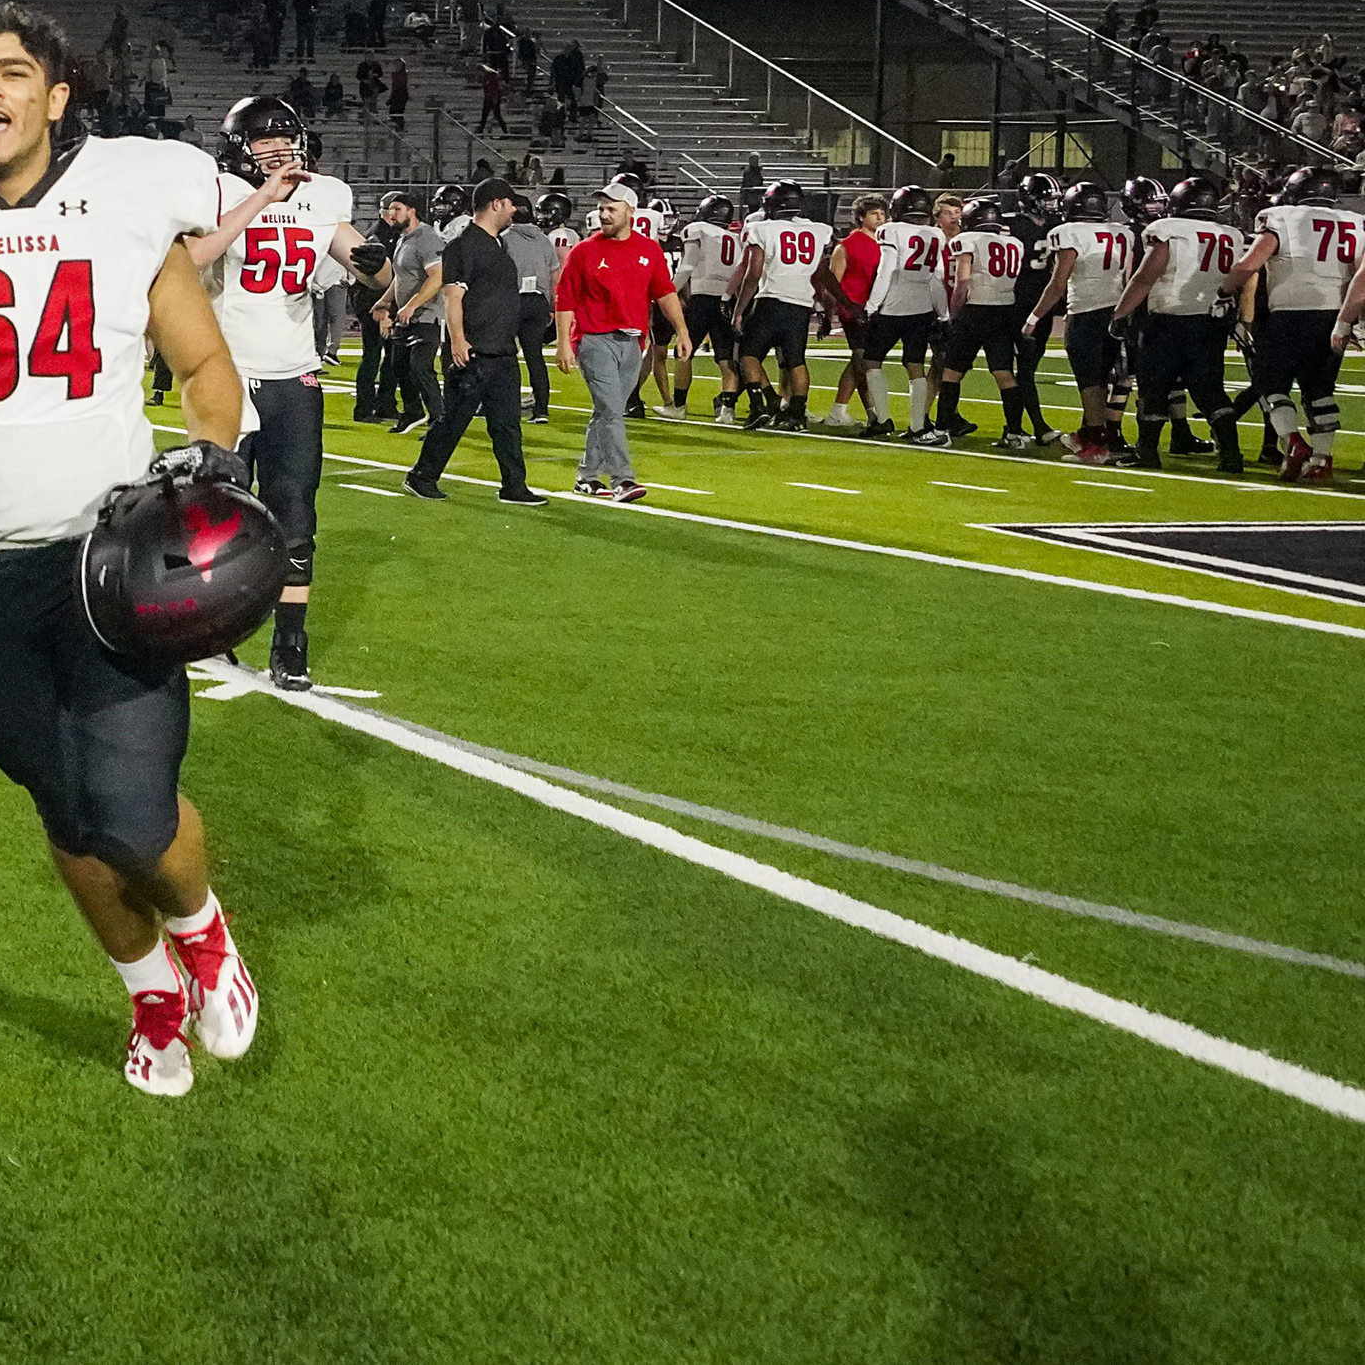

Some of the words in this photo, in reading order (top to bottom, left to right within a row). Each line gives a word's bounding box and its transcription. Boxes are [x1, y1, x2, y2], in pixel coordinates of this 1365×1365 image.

[261, 214, 297, 224] MELISSA
[779, 230, 816, 266] 69
[903, 235, 940, 273] 24
[988, 241, 1019, 279] 80
[1095, 232, 1128, 270] 71
[1197, 232, 1234, 274] 76
[1312, 219, 1357, 264] 75
[239, 227, 317, 295] 55
